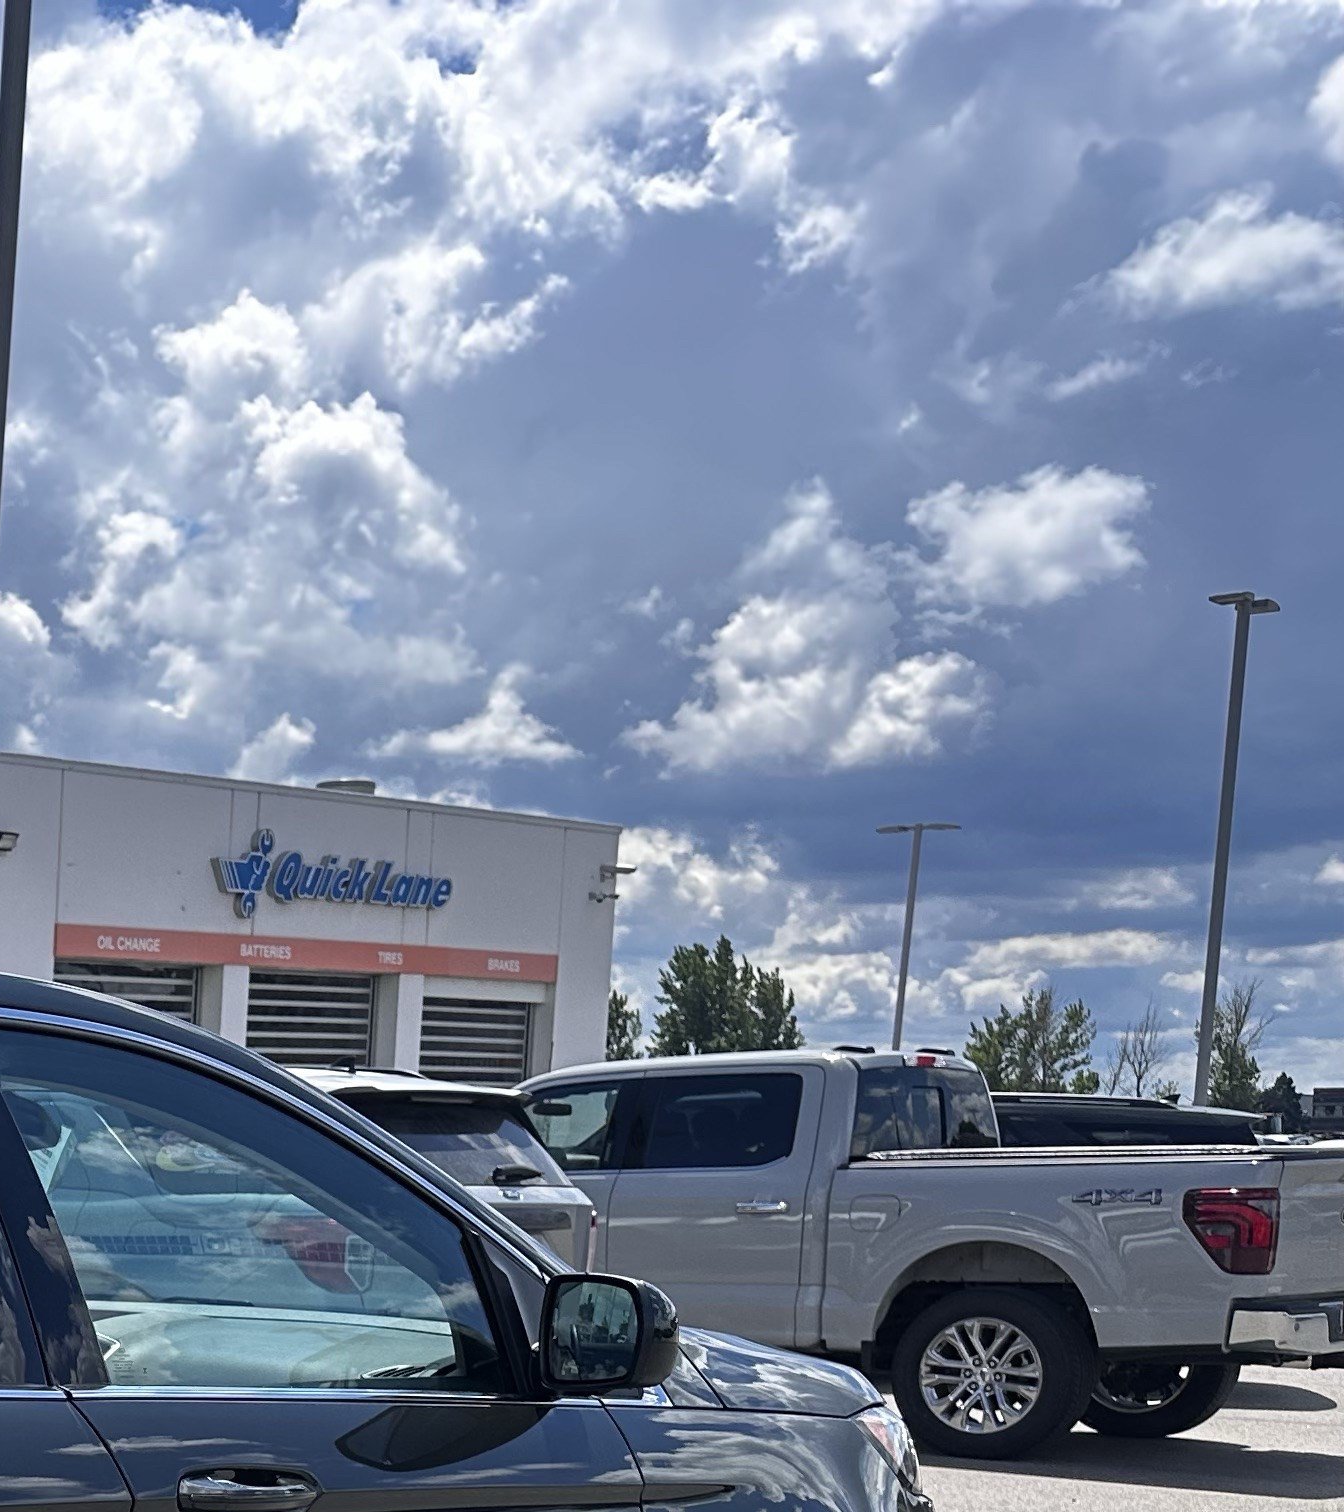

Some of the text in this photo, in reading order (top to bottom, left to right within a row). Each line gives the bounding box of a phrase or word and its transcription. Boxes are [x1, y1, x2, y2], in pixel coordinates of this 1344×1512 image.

[97, 935, 160, 953] OIL CHANGE
[240, 943, 292, 960] BATTERIES
[378, 951, 403, 965] TIRES
[487, 958, 520, 973] BRAKES
